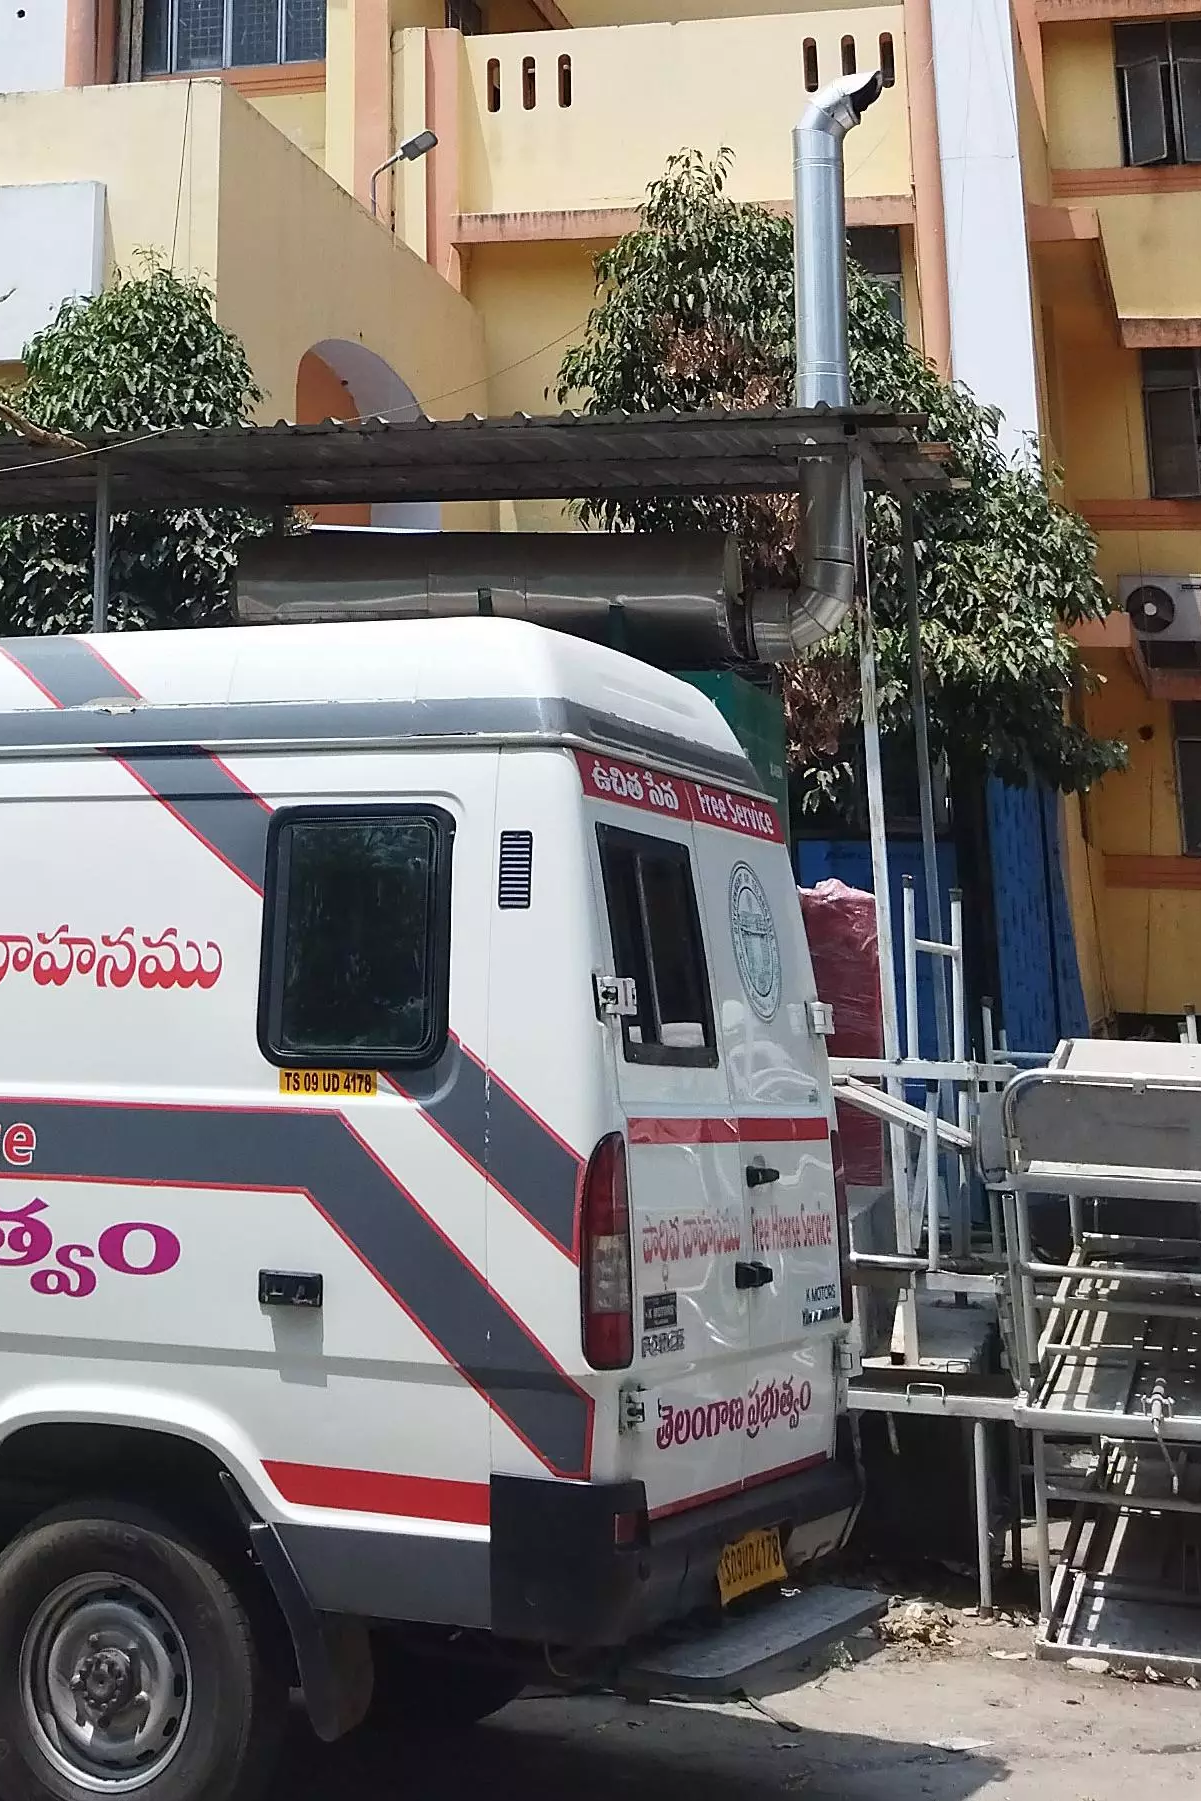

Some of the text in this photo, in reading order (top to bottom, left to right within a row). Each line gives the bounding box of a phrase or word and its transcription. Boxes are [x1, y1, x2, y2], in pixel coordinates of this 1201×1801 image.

[591, 760, 679, 810] ఉచిత సేవ
[696, 784, 775, 834] Free Service
[284, 1072, 372, 1093] TS 09 UD 4178
[656, 1374, 812, 1450] తెలంగాణ ప్రభుత్వం
